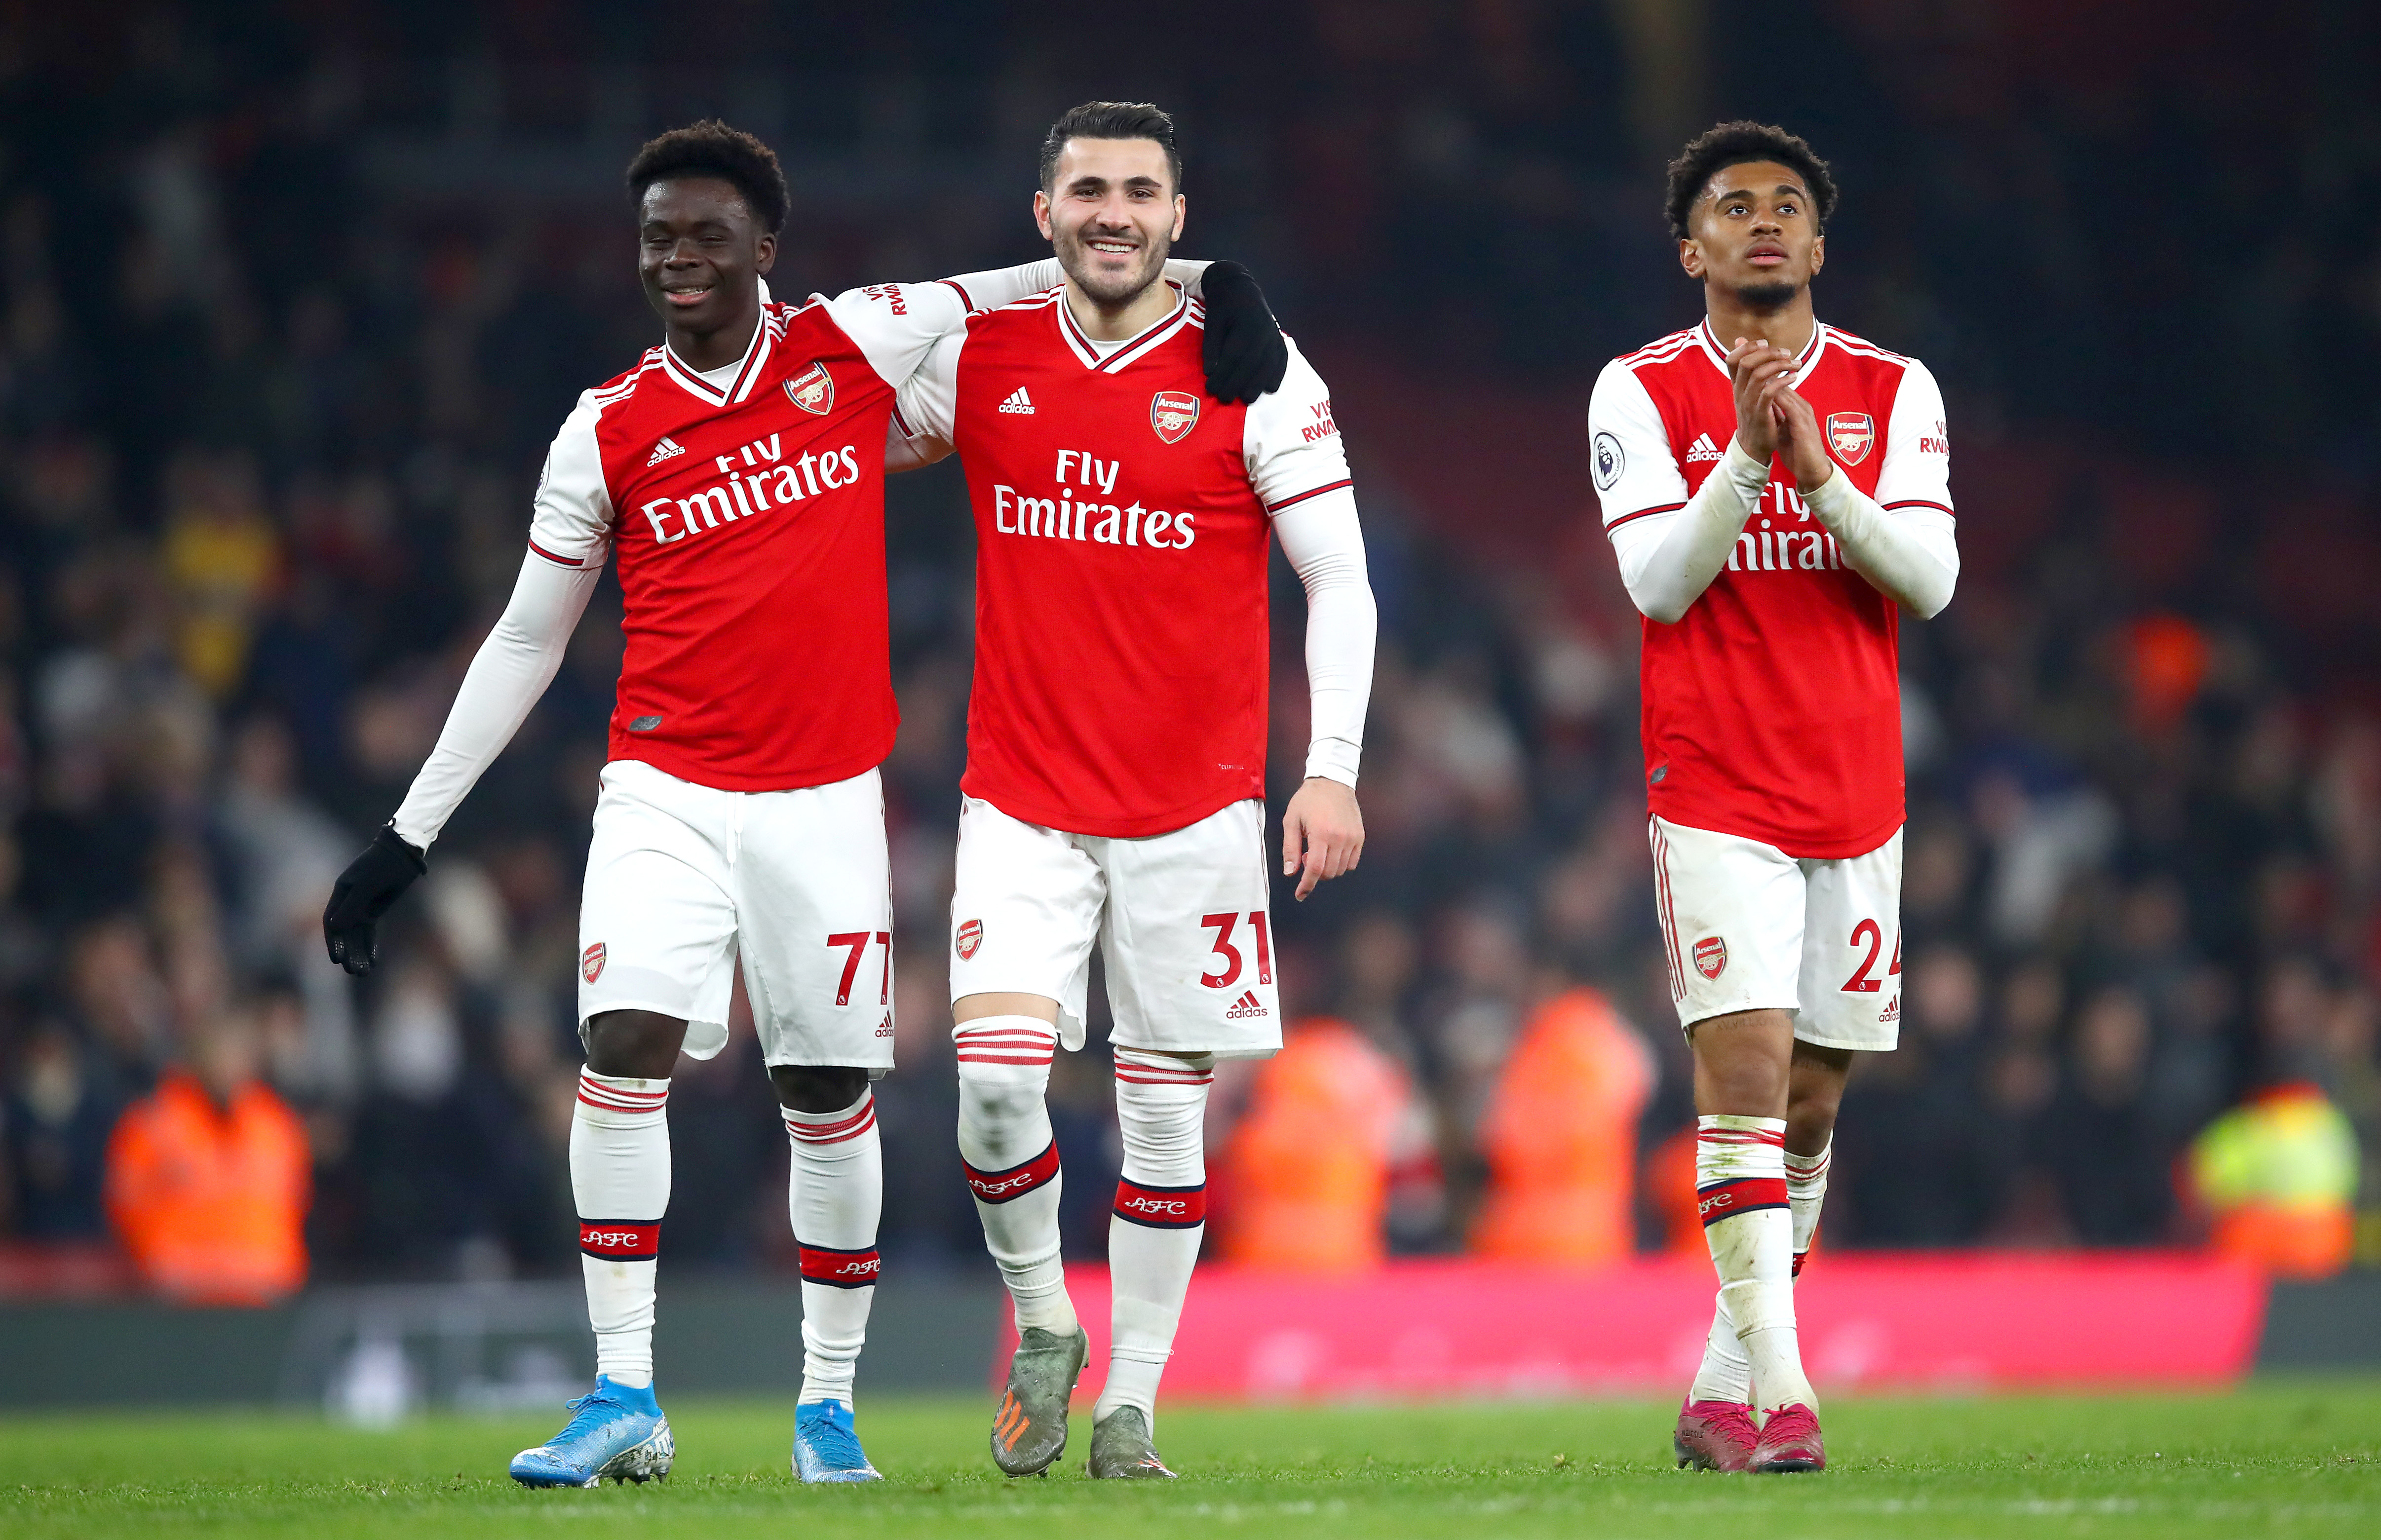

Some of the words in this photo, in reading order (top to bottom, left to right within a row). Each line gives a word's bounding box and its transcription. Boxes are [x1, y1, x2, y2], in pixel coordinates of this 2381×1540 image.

[790, 367, 821, 390] Arsenal
[998, 402, 1036, 415] adidas
[1158, 398, 1193, 411] Arsenal
[1833, 421, 1868, 429] Arsenal
[647, 446, 686, 467] adidas
[1686, 450, 1725, 463] adidas
[1056, 449, 1119, 495] Fly
[641, 445, 860, 545] Emirates
[994, 484, 1195, 550] Emirates
[1727, 519, 1840, 572] mirat
[959, 924, 980, 938] Arsenal
[1200, 911, 1272, 989] 31
[1696, 942, 1722, 955] Arsenal
[1226, 1007, 1268, 1019] adidas
[968, 1173, 1033, 1194] AFC
[1124, 1197, 1187, 1215] AFC
[581, 1231, 639, 1247] AFC
